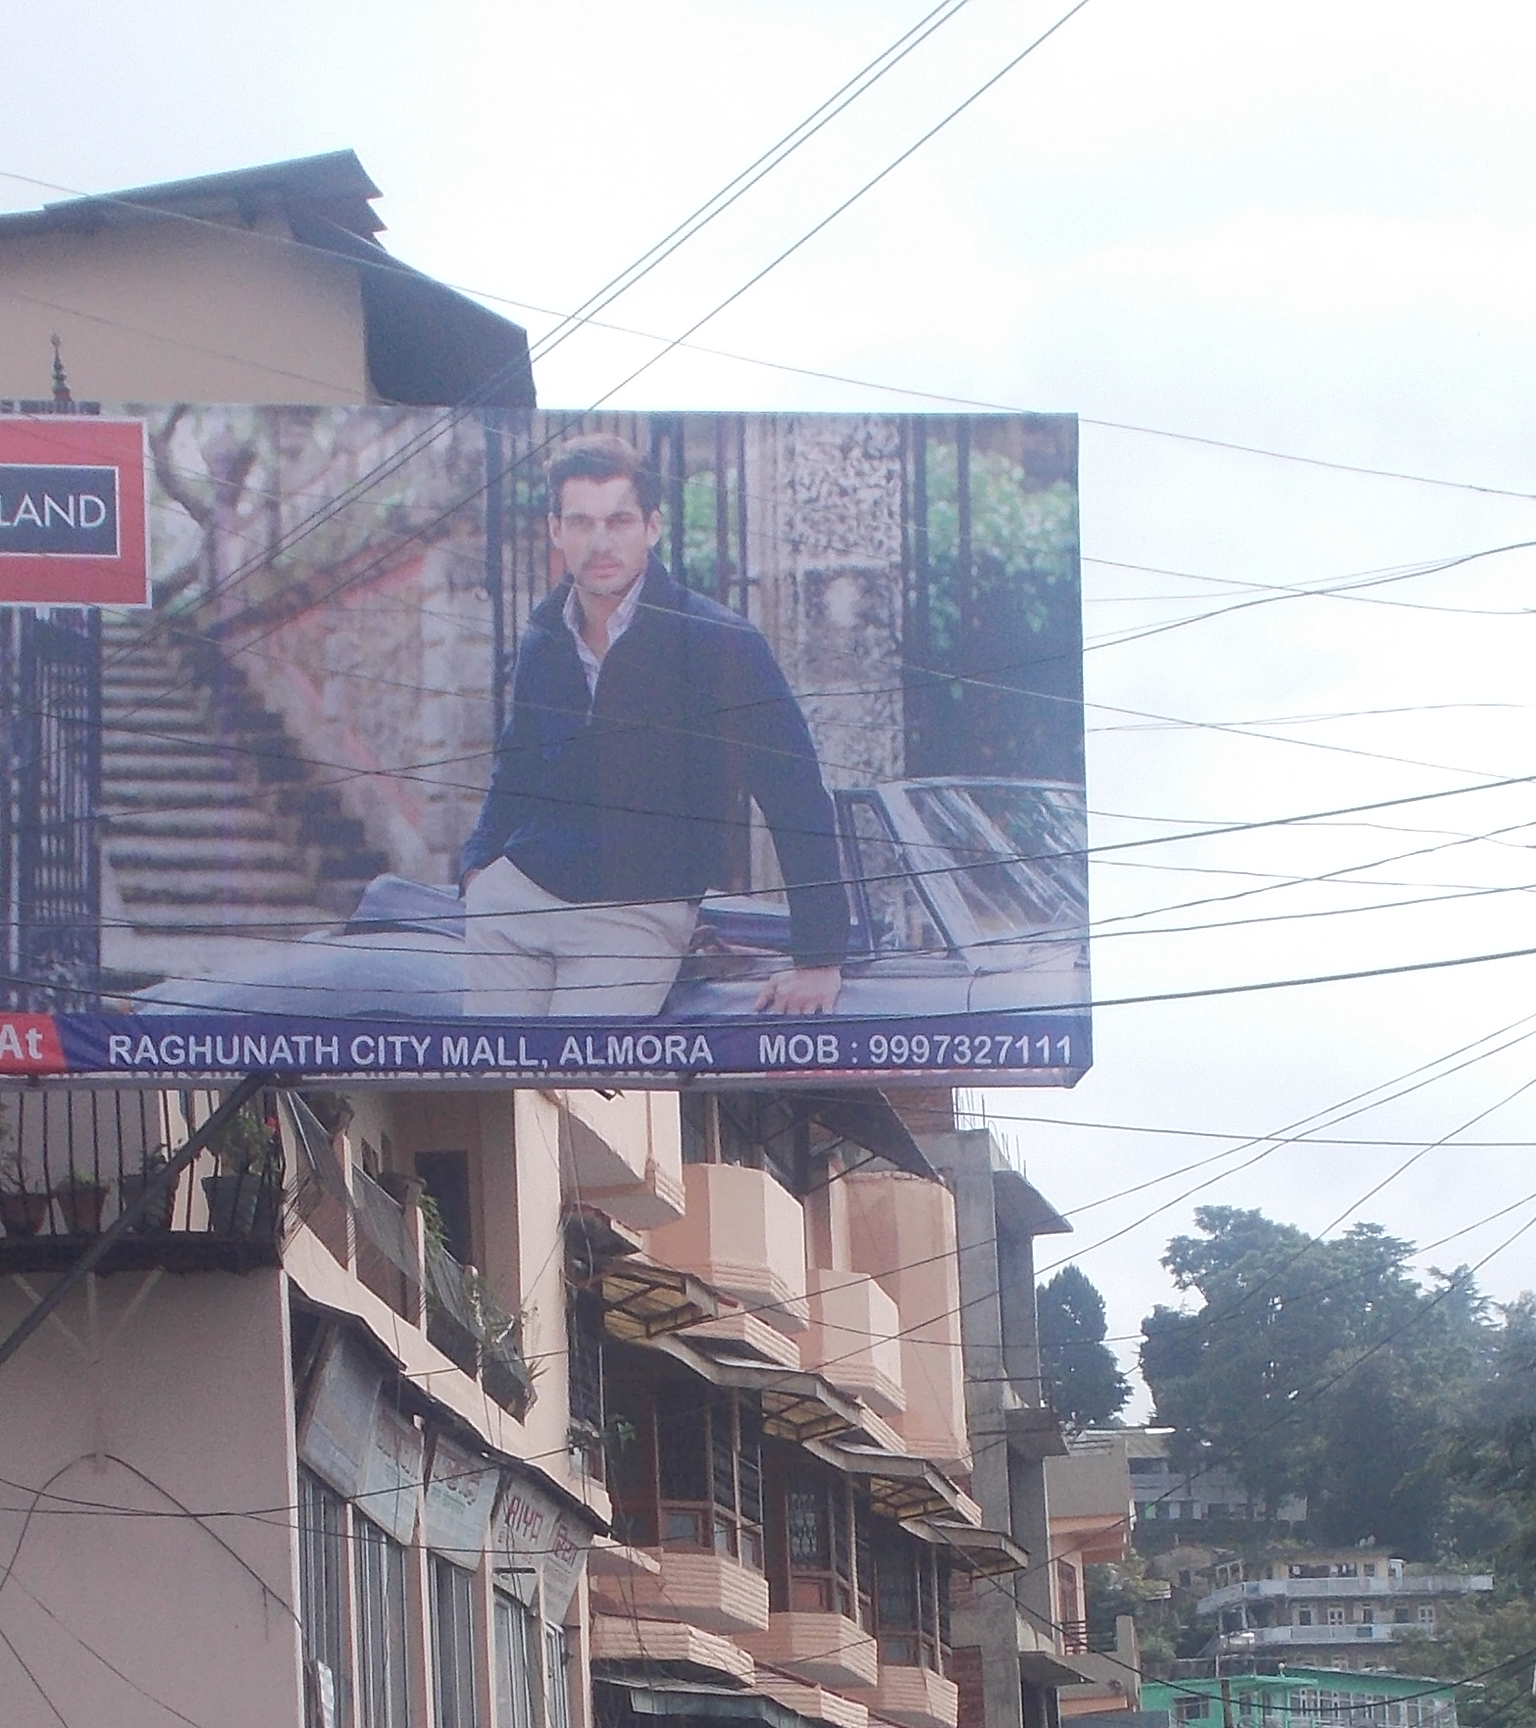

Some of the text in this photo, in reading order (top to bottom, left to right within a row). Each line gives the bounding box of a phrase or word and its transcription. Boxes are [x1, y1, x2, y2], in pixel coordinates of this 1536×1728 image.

[108, 1033, 714, 1069] RAGHUNATH CITY MALL, ALMORA
[759, 1034, 841, 1064] MOB
[868, 1033, 1072, 1066] 9997327111
